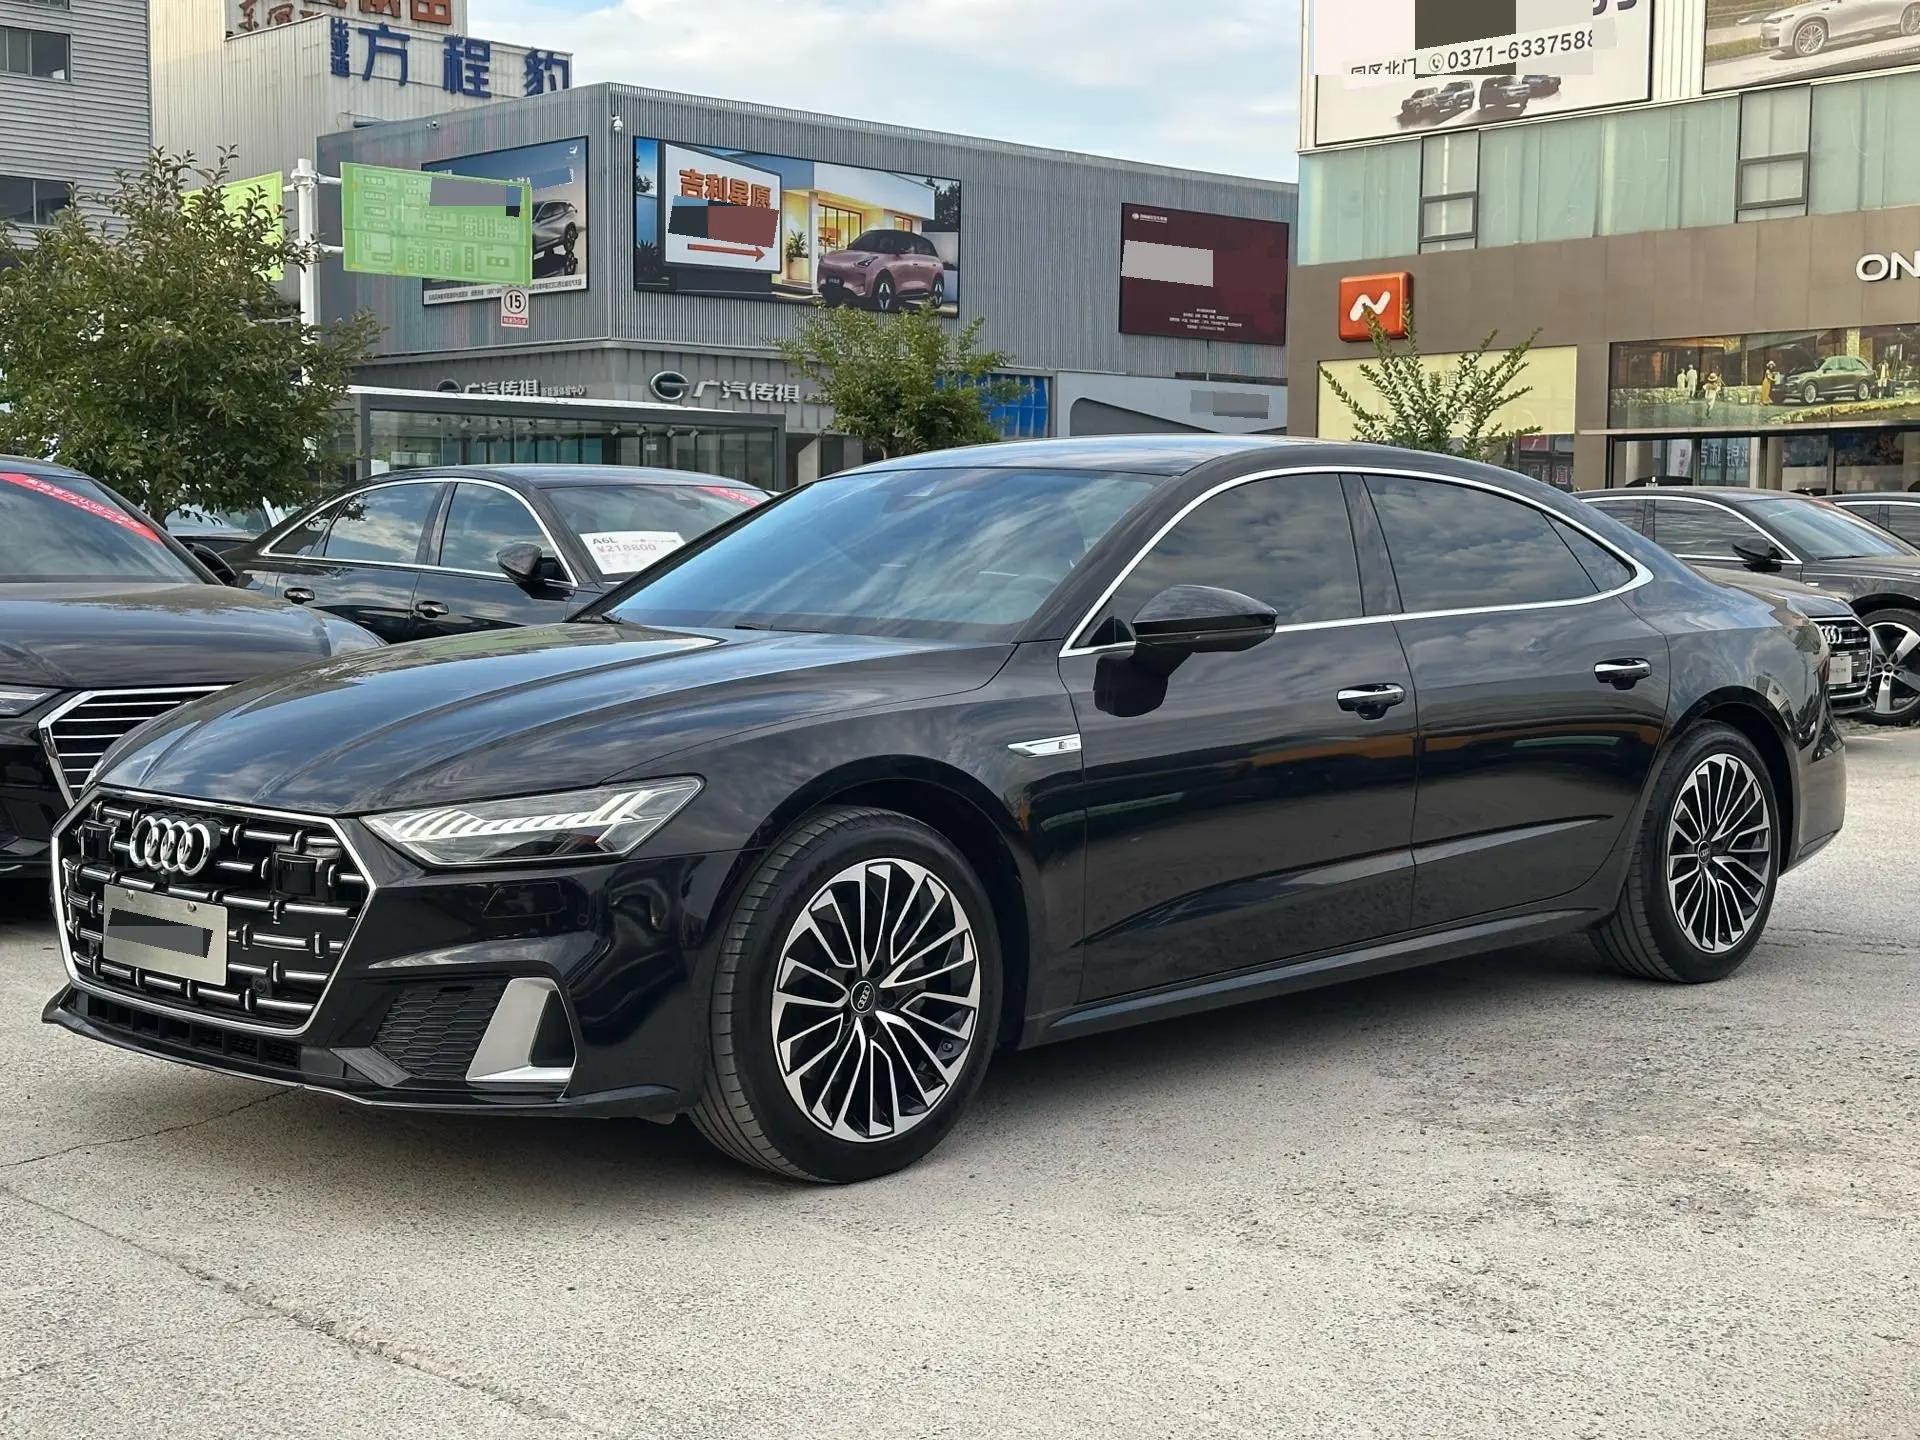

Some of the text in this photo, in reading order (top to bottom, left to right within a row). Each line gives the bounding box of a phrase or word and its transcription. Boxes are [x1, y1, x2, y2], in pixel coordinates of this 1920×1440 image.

[330, 17, 350, 78] 比亚迪
[358, 23, 570, 98] 方程豹
[679, 168, 771, 209] 吉利星愿
[509, 294, 521, 308] 15
[693, 380, 800, 403] 广汽传祺
